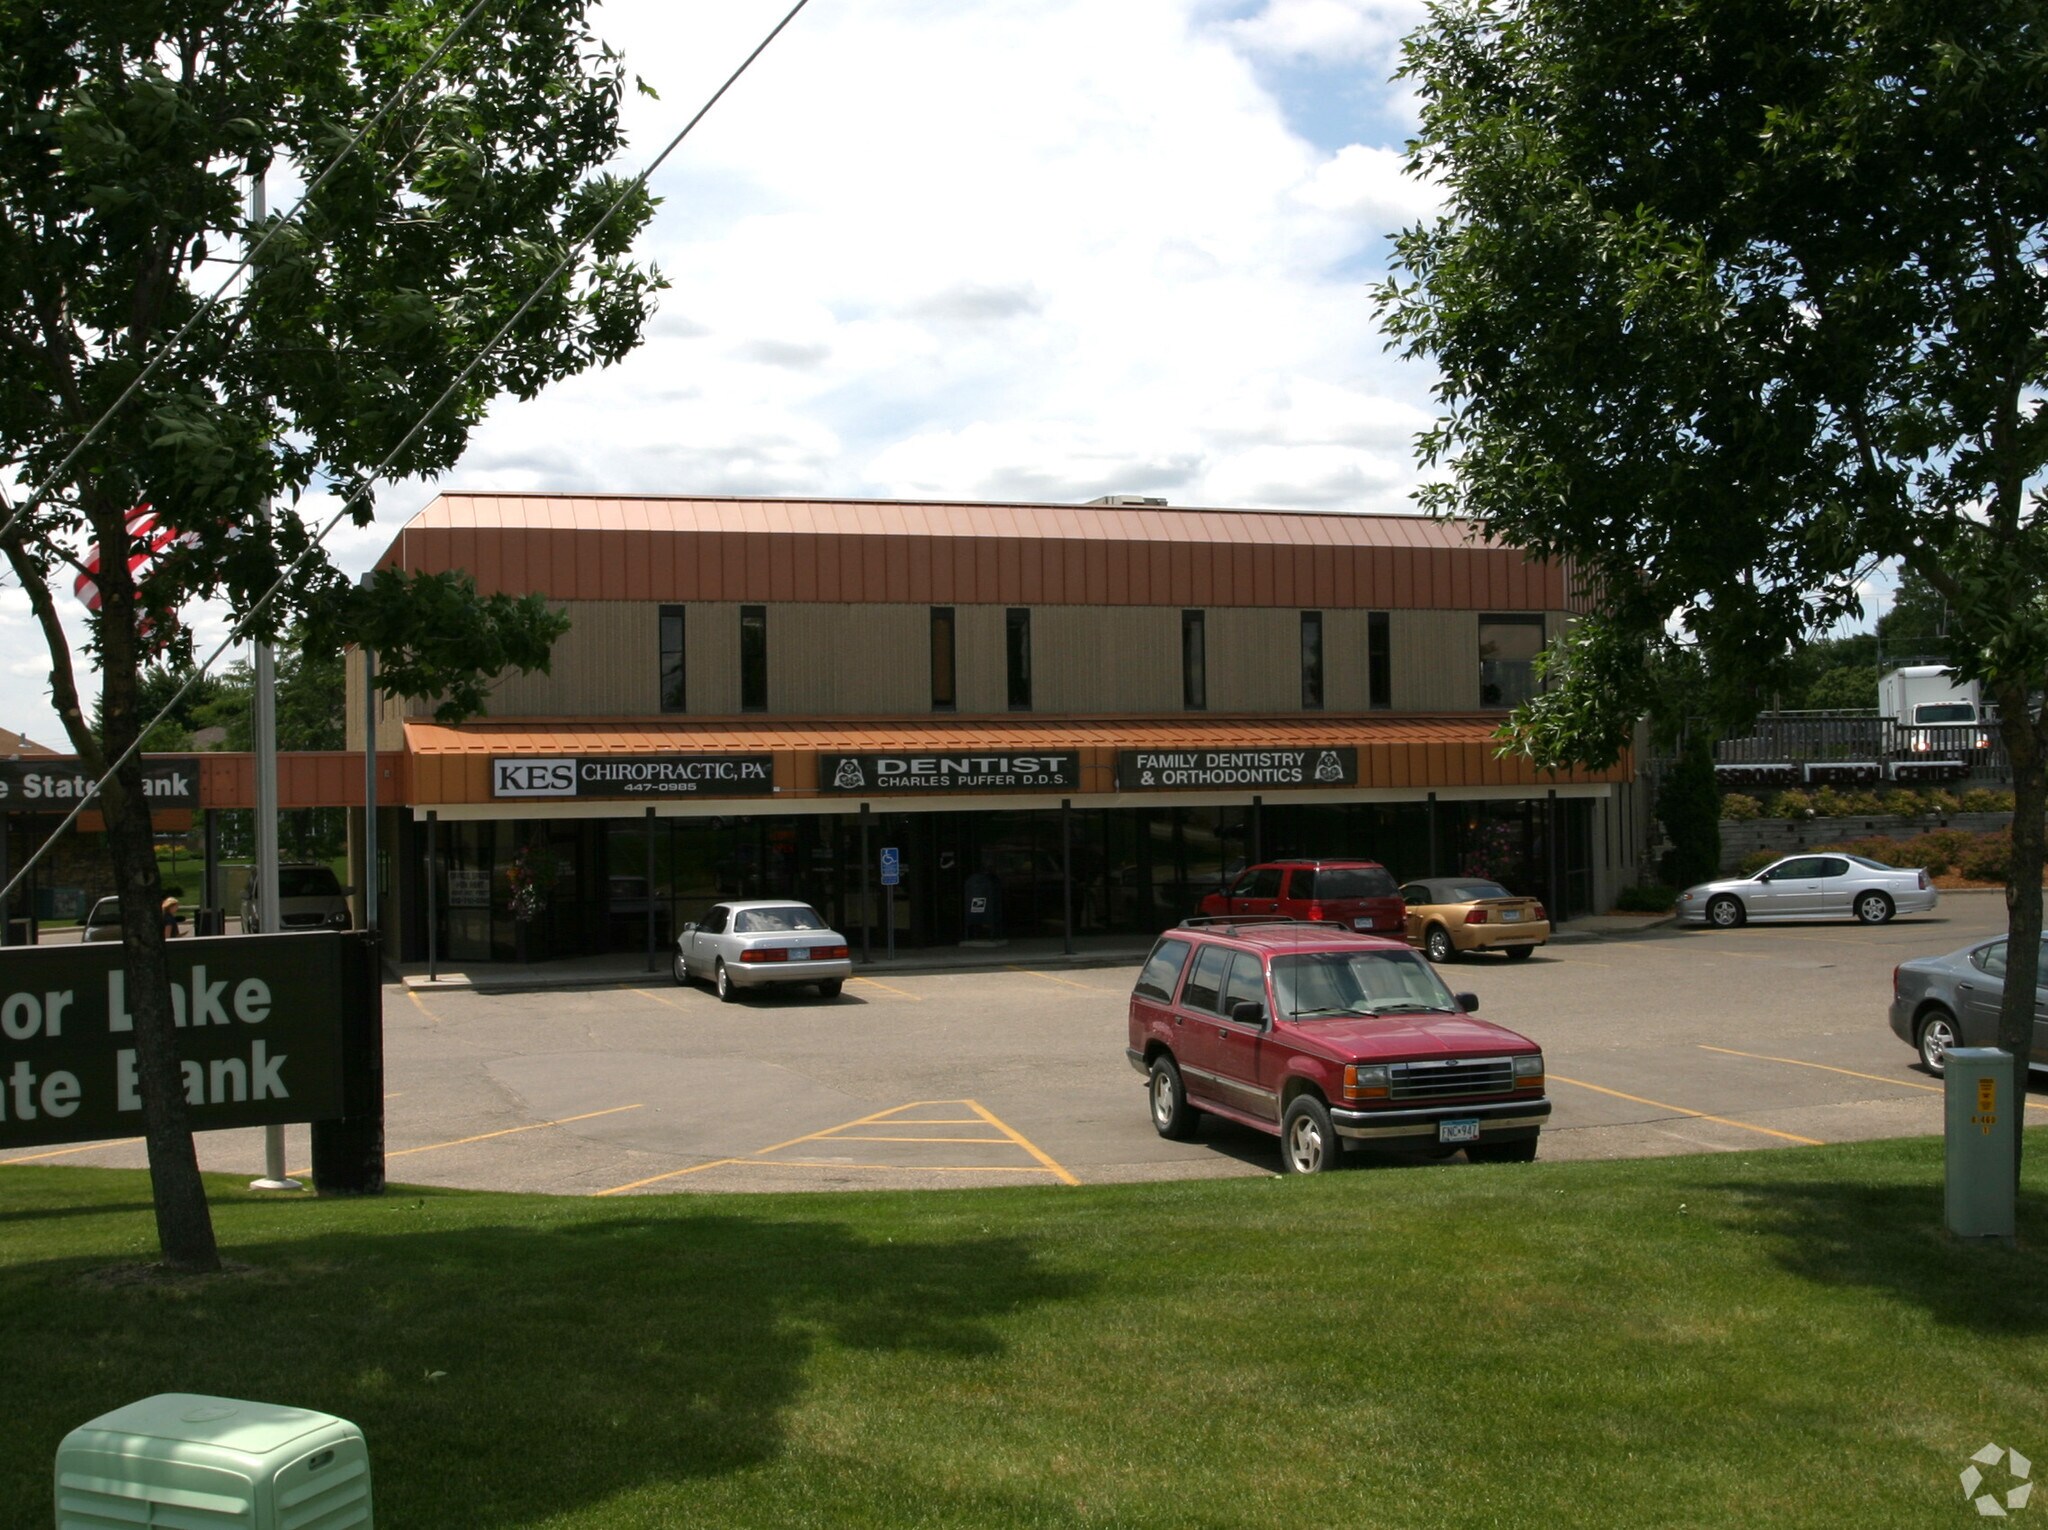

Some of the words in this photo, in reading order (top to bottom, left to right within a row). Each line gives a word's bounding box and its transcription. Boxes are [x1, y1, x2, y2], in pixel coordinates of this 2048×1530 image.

[877, 757, 1067, 774] DENTIST
[1137, 754, 1197, 768] FAMILY
[1206, 752, 1305, 767] DENTISTRY
[499, 766, 573, 790] KES
[581, 763, 738, 781] CHIROPRACTIC,
[741, 763, 766, 778] PA
[877, 776, 950, 787] CHARLES
[958, 775, 1015, 785] PUFFER
[1022, 774, 1068, 785] D.D.S.
[1140, 771, 1155, 785] &
[1162, 768, 1302, 784] ORTHODONTICS
[141, 773, 189, 796] ank
[624, 782, 697, 791] 447-0985
